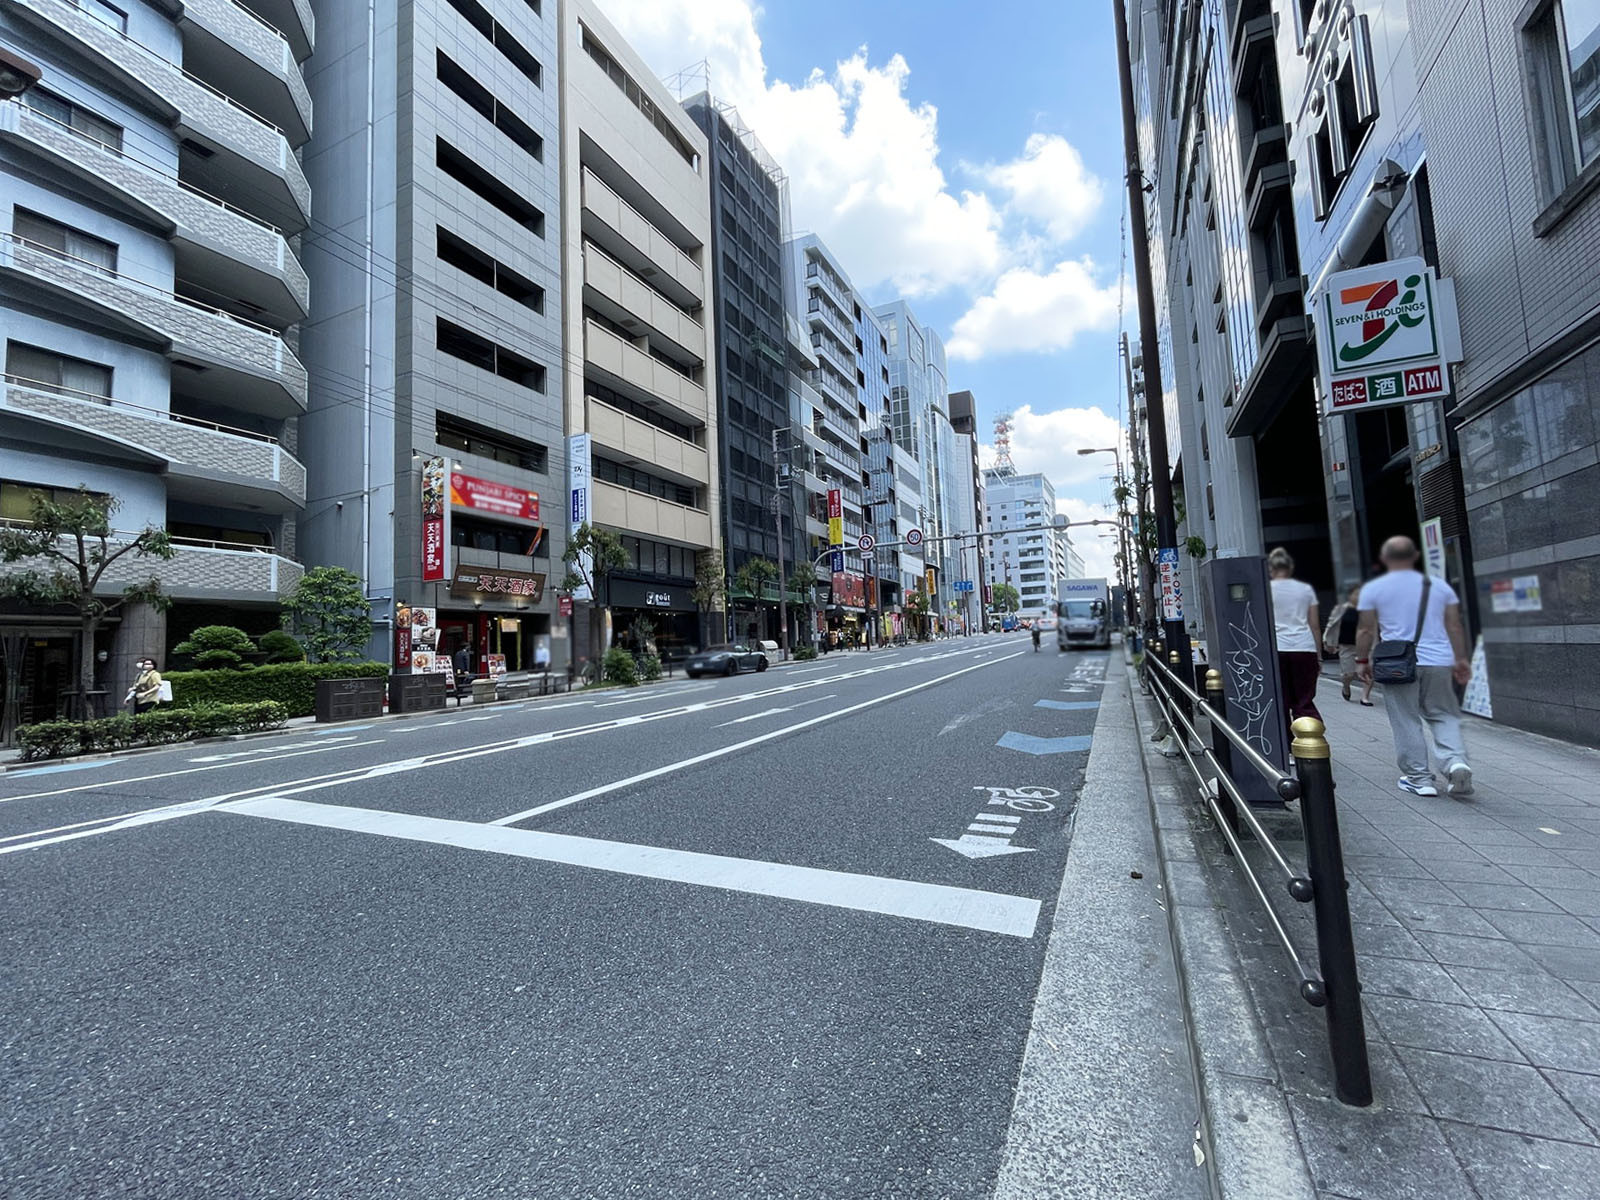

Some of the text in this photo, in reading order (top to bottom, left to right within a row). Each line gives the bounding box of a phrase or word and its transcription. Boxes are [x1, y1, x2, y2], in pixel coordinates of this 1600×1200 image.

[1378, 302, 1425, 318] HOLDINGS
[1334, 370, 1441, 403] たばこ 酒 ATM
[910, 533, 919, 541] 50
[476, 574, 537, 597] 天天酒家
[1066, 584, 1098, 592] SAGAWA
